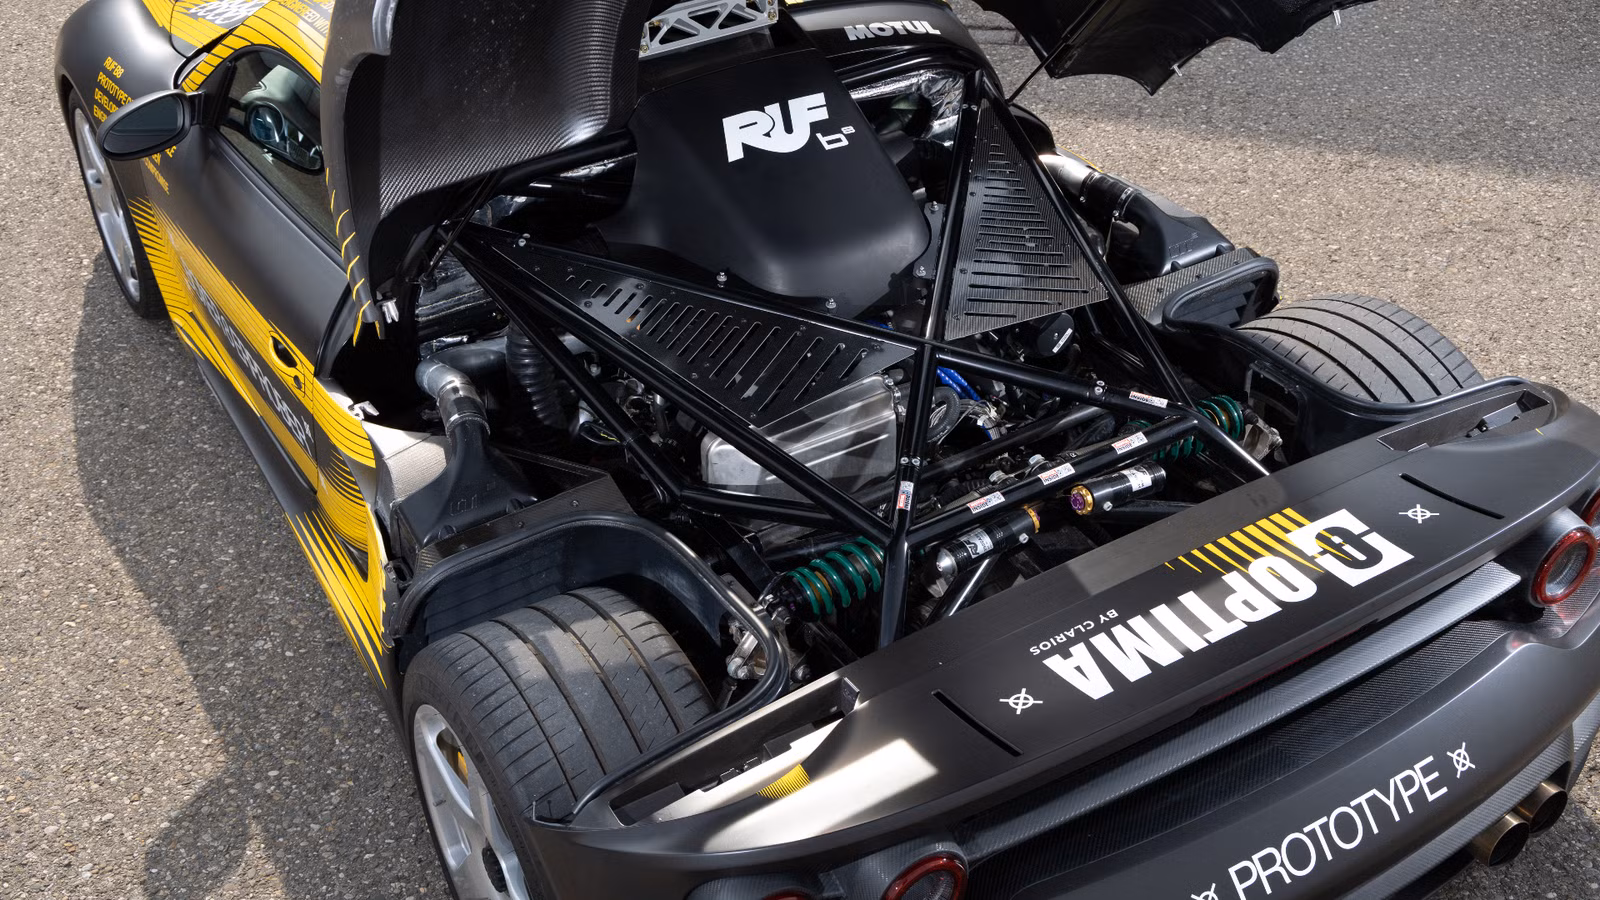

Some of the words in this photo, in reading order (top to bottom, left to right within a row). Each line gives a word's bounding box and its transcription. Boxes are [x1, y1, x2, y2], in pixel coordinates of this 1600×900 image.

[843, 20, 941, 41] MOTUL
[104, 56, 118, 71] RUF
[97, 71, 128, 106] PROTOTYPE
[722, 92, 829, 163] RUF
[1042, 556, 1318, 700] OPTIMA
[1099, 609, 1119, 624] BY
[1029, 620, 1095, 656] CLARIOS
[1228, 755, 1448, 900] PROTOTYPE
